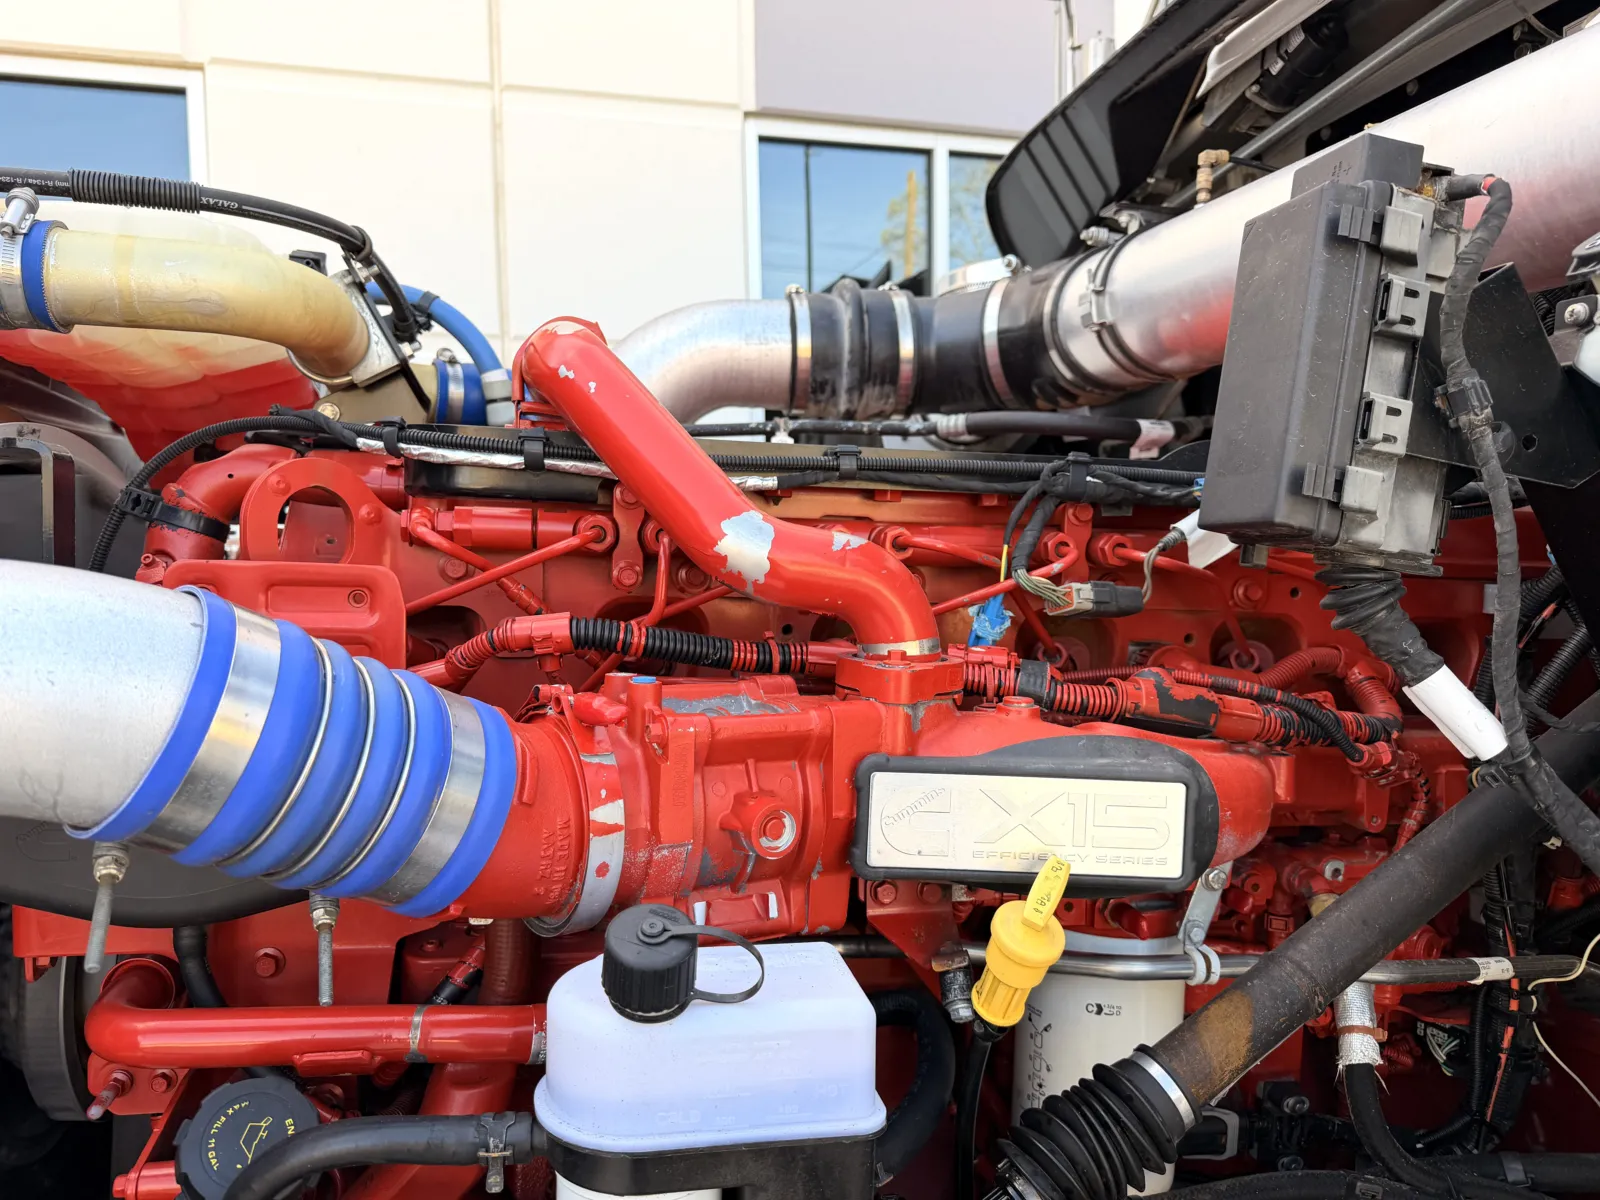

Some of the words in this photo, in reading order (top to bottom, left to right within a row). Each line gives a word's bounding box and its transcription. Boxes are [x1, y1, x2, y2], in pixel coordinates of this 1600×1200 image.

[0, 176, 22, 184] R-123
[28, 178, 54, 187] R-134a
[200, 196, 239, 209] GALAX
[973, 787, 1170, 851] X15
[1095, 854, 1168, 866] SERIES
[226, 1100, 250, 1116] MAX
[210, 1115, 227, 1135] FILL
[284, 1118, 296, 1136] EN
[208, 1150, 220, 1171] GAL
